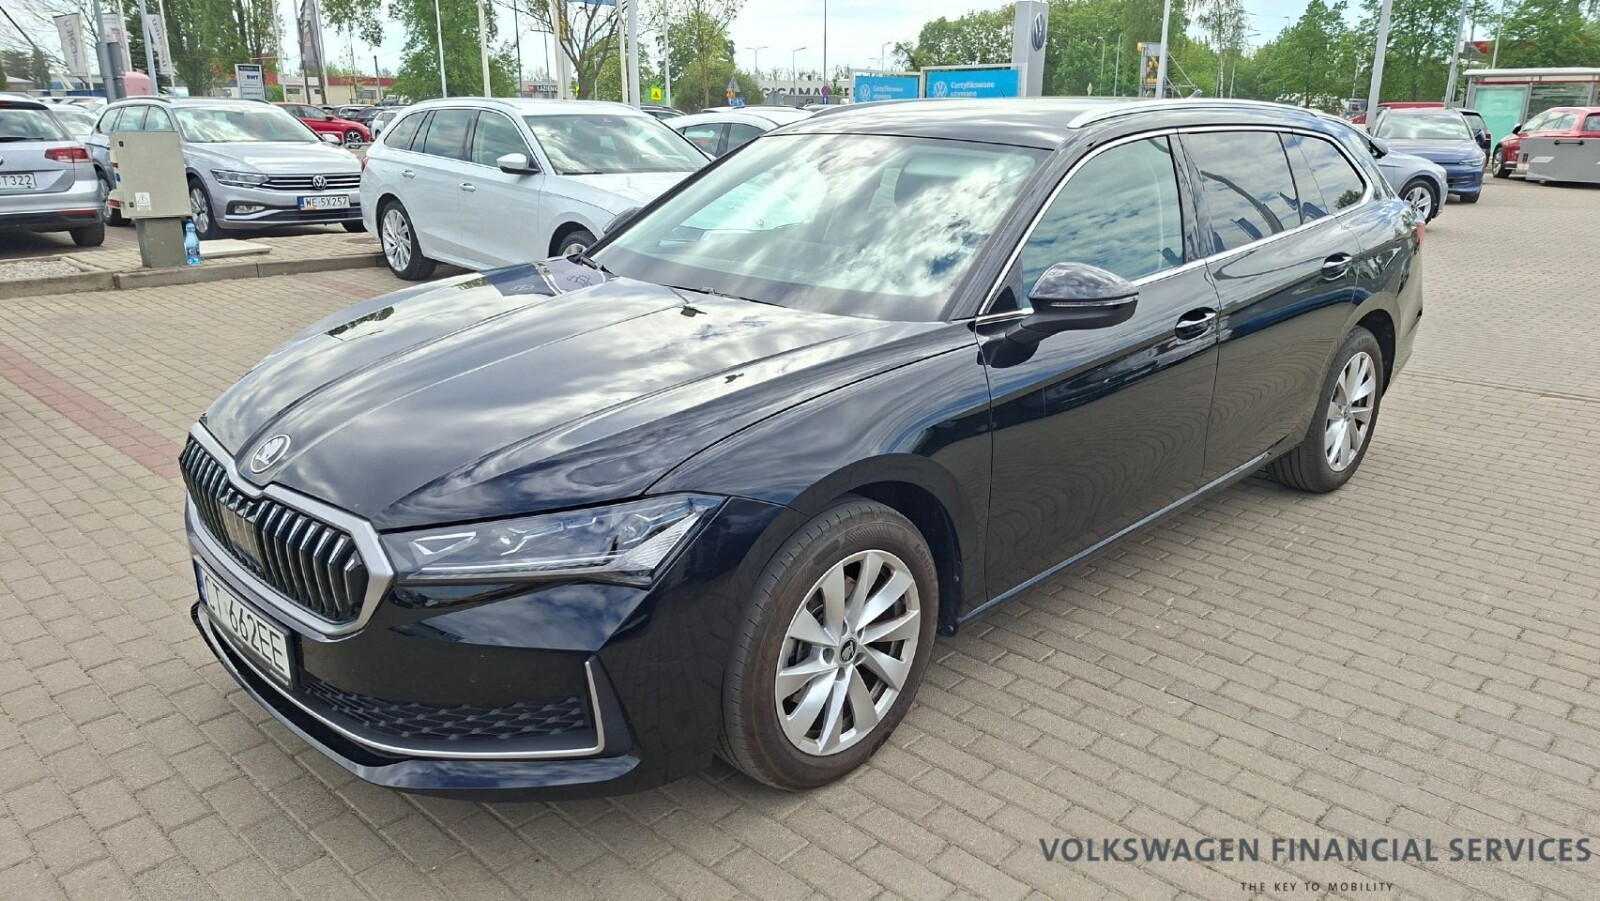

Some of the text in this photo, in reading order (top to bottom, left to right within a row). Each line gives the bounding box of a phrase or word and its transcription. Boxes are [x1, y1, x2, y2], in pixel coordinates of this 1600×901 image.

[950, 81, 996, 91] Certyfikowane
[0, 175, 32, 186] T322
[305, 197, 318, 208] WE
[204, 575, 286, 673] CT 662EE
